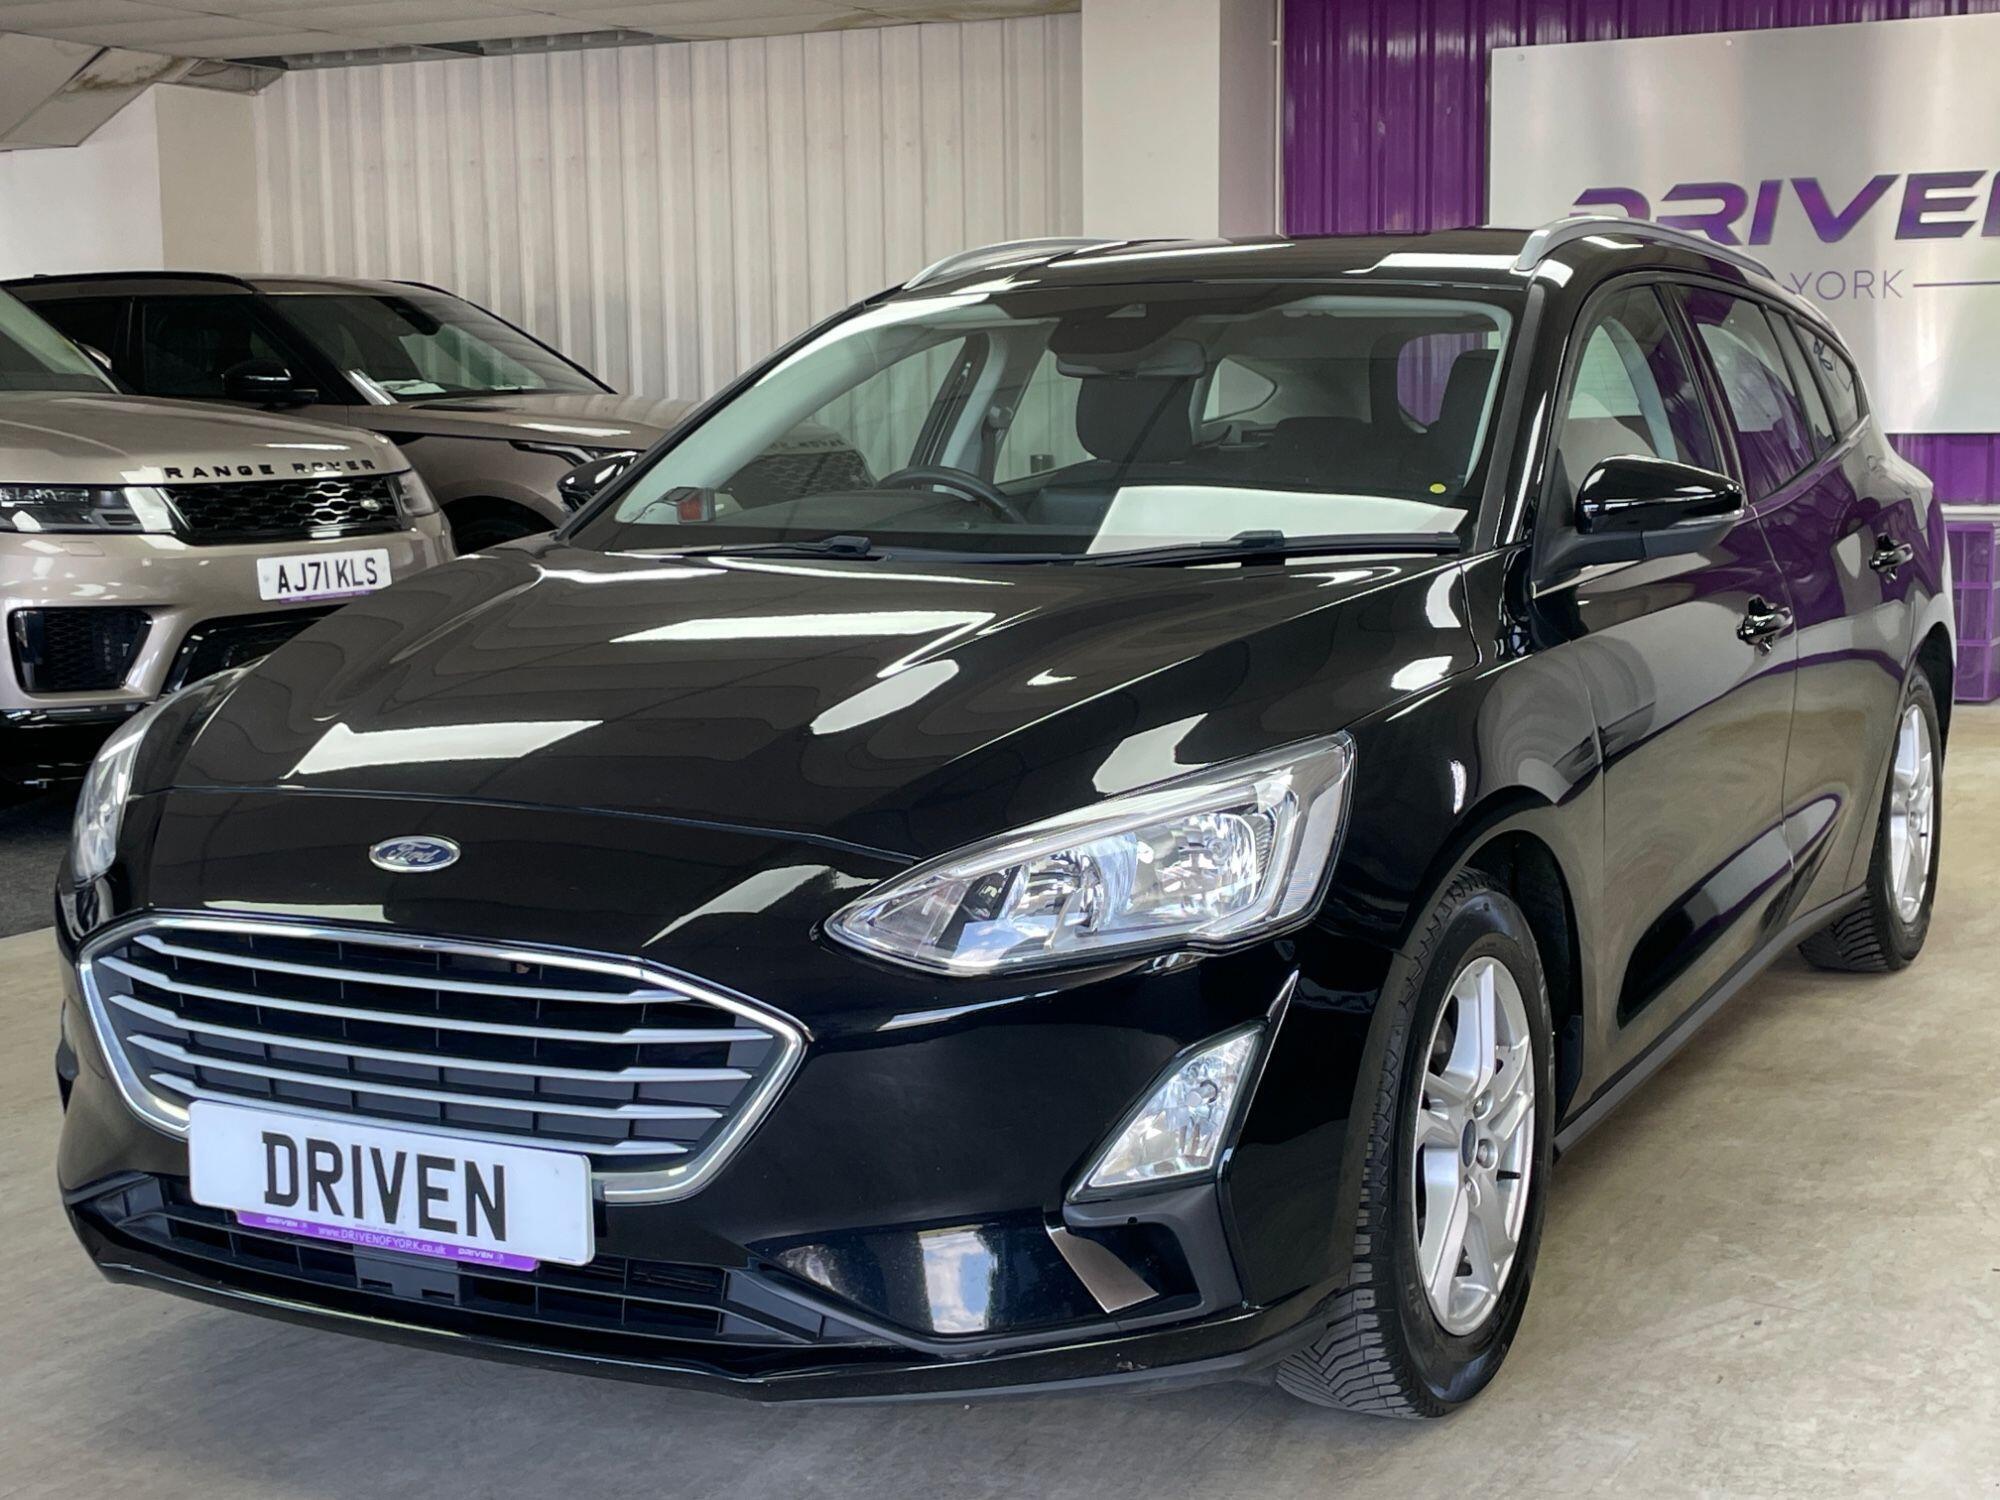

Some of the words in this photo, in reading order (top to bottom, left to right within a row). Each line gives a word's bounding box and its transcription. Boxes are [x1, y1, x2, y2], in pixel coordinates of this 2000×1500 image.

[1569, 169, 2000, 247] DRIVE
[1788, 269, 1905, 300] YORK
[164, 464, 275, 480] RANGE
[277, 561, 330, 594] AJ71
[336, 557, 378, 588] KLS
[261, 1131, 507, 1242] DRIVEN
[458, 1247, 494, 1260] DRIVEN
